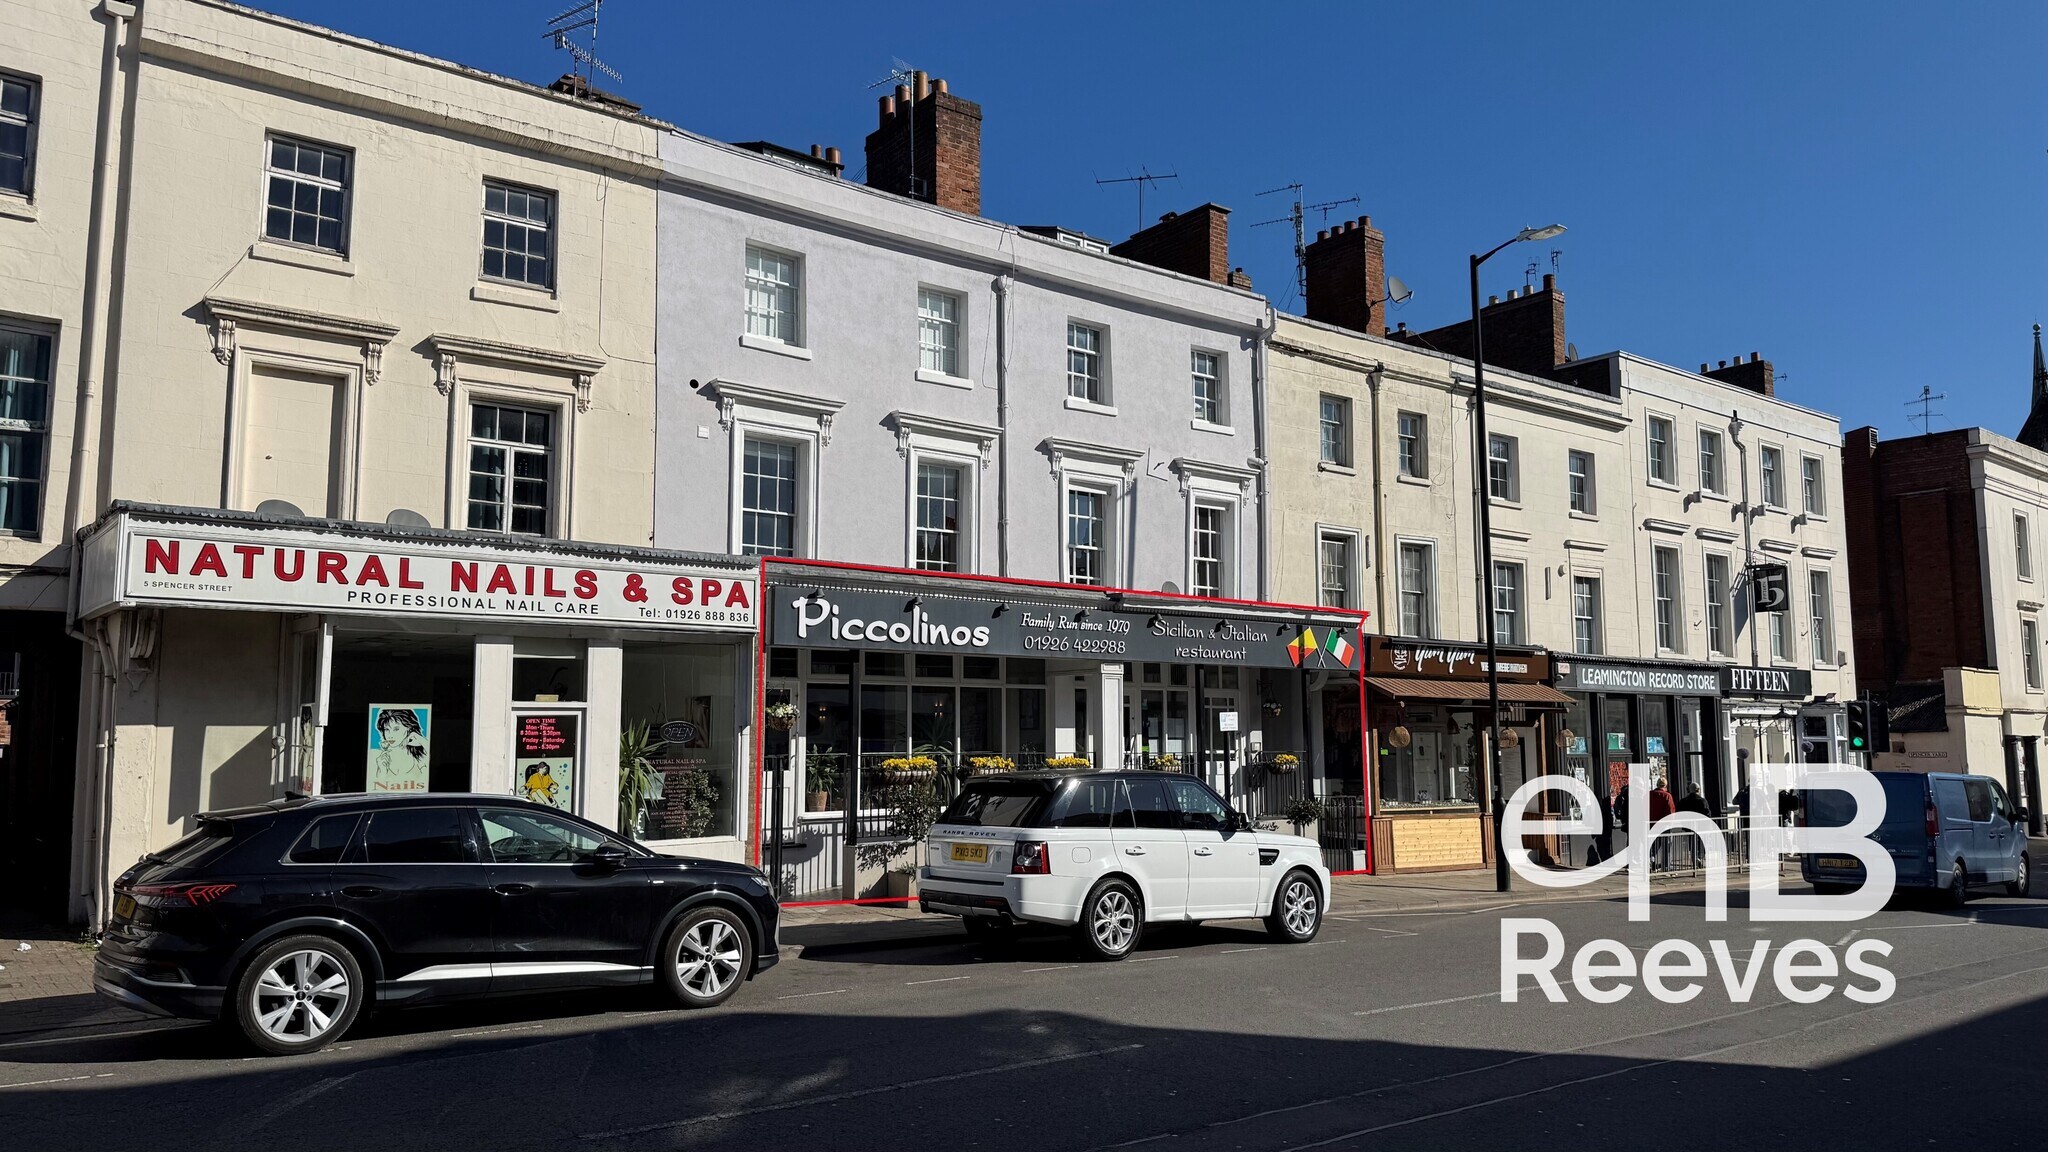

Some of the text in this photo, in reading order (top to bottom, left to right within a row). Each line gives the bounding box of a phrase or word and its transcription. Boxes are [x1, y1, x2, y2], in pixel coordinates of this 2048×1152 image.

[145, 539, 750, 609] NATURAL NAILS & SPA
[152, 581, 195, 591] SPENCER
[198, 584, 233, 592] STREET
[1756, 573, 1785, 608] 15
[347, 590, 599, 615] PROFESSIONAL NAIL CARE
[639, 607, 749, 623] Tel: 01926 888 836
[791, 596, 990, 647] Piccolinos
[1021, 612, 1131, 636] Family Run since 1979
[1151, 619, 1268, 643] Sicilian & Italian
[1024, 635, 1126, 654] 01926 422988
[1175, 645, 1247, 660] restaurant
[1582, 668, 1646, 687] LEAMINGTON
[1649, 672, 1685, 689] RECORD
[1687, 673, 1716, 690] STORE
[1731, 668, 1790, 692] FIFTEEN
[664, 727, 694, 737] OPEN
[373, 780, 425, 791] Nails
